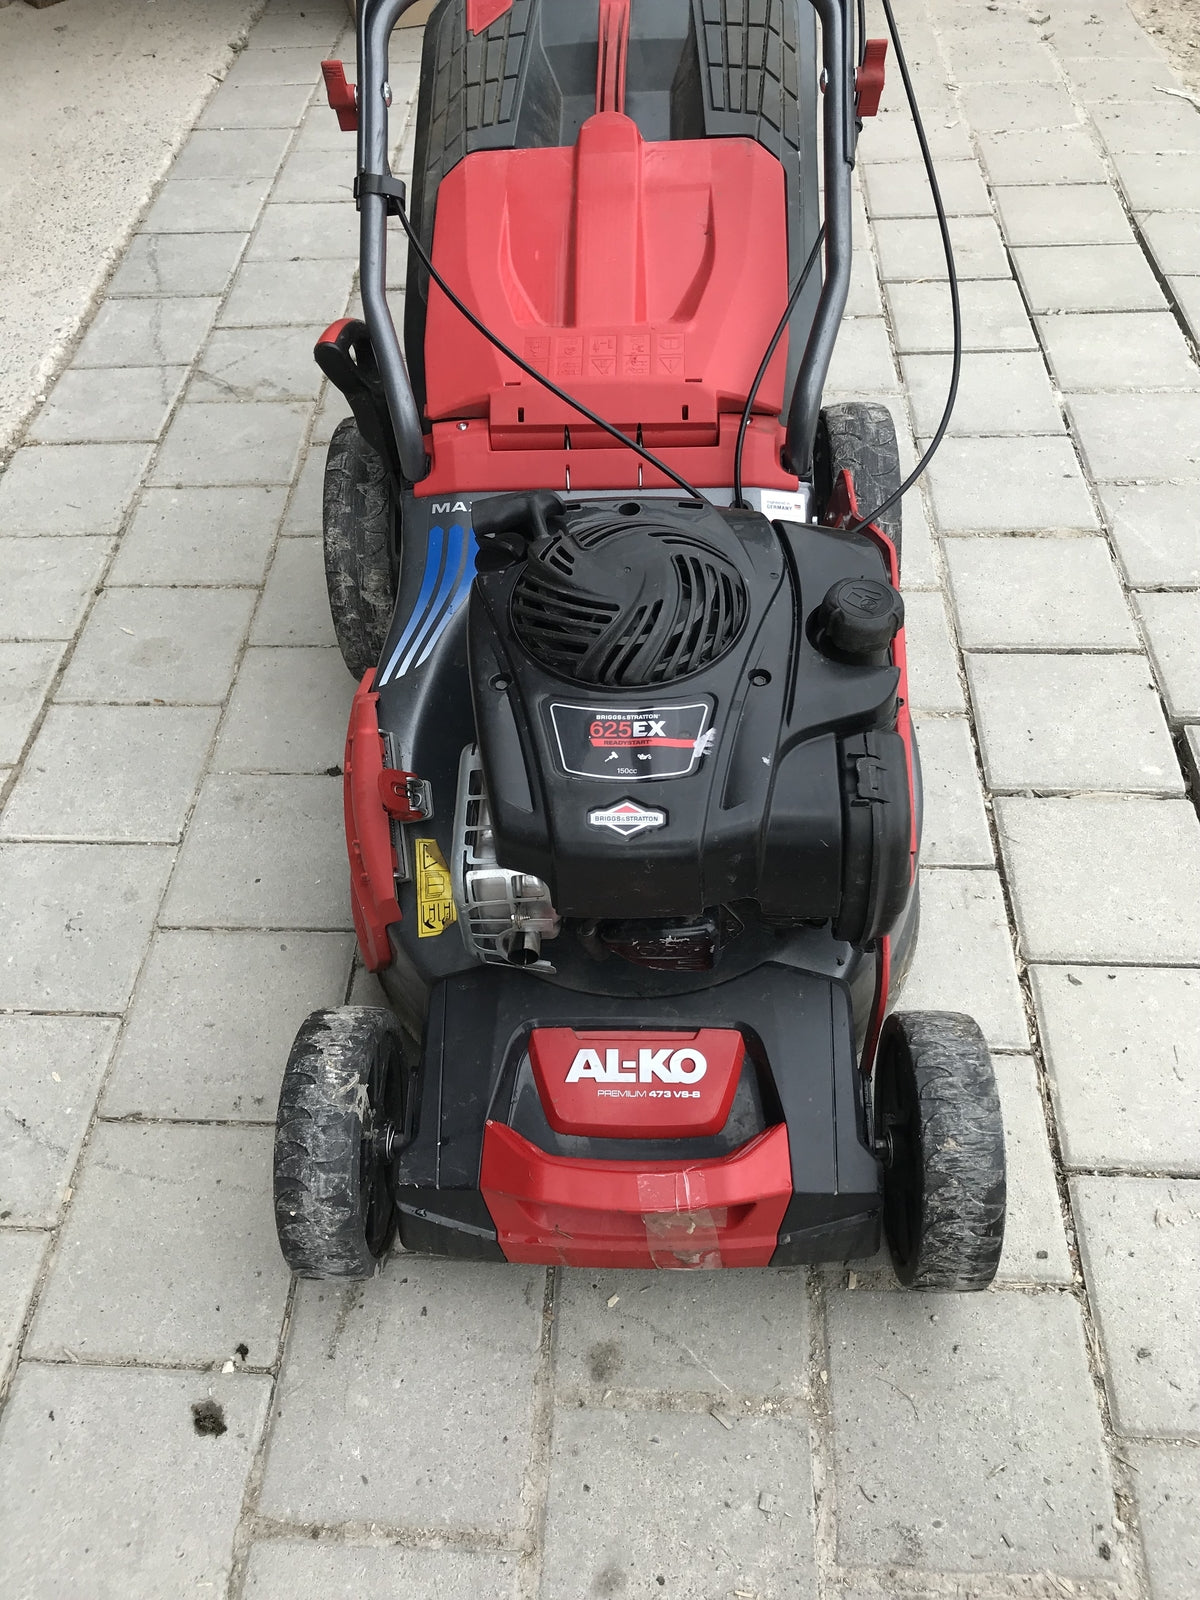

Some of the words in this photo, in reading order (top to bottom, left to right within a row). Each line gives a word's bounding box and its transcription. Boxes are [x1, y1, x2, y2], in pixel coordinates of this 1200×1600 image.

[766, 503, 792, 511] GERMANY
[590, 720, 666, 737] 625EX
[564, 1048, 708, 1085] AL-KO
[597, 1090, 647, 1098] PREMIUM
[648, 1090, 671, 1098] 473
